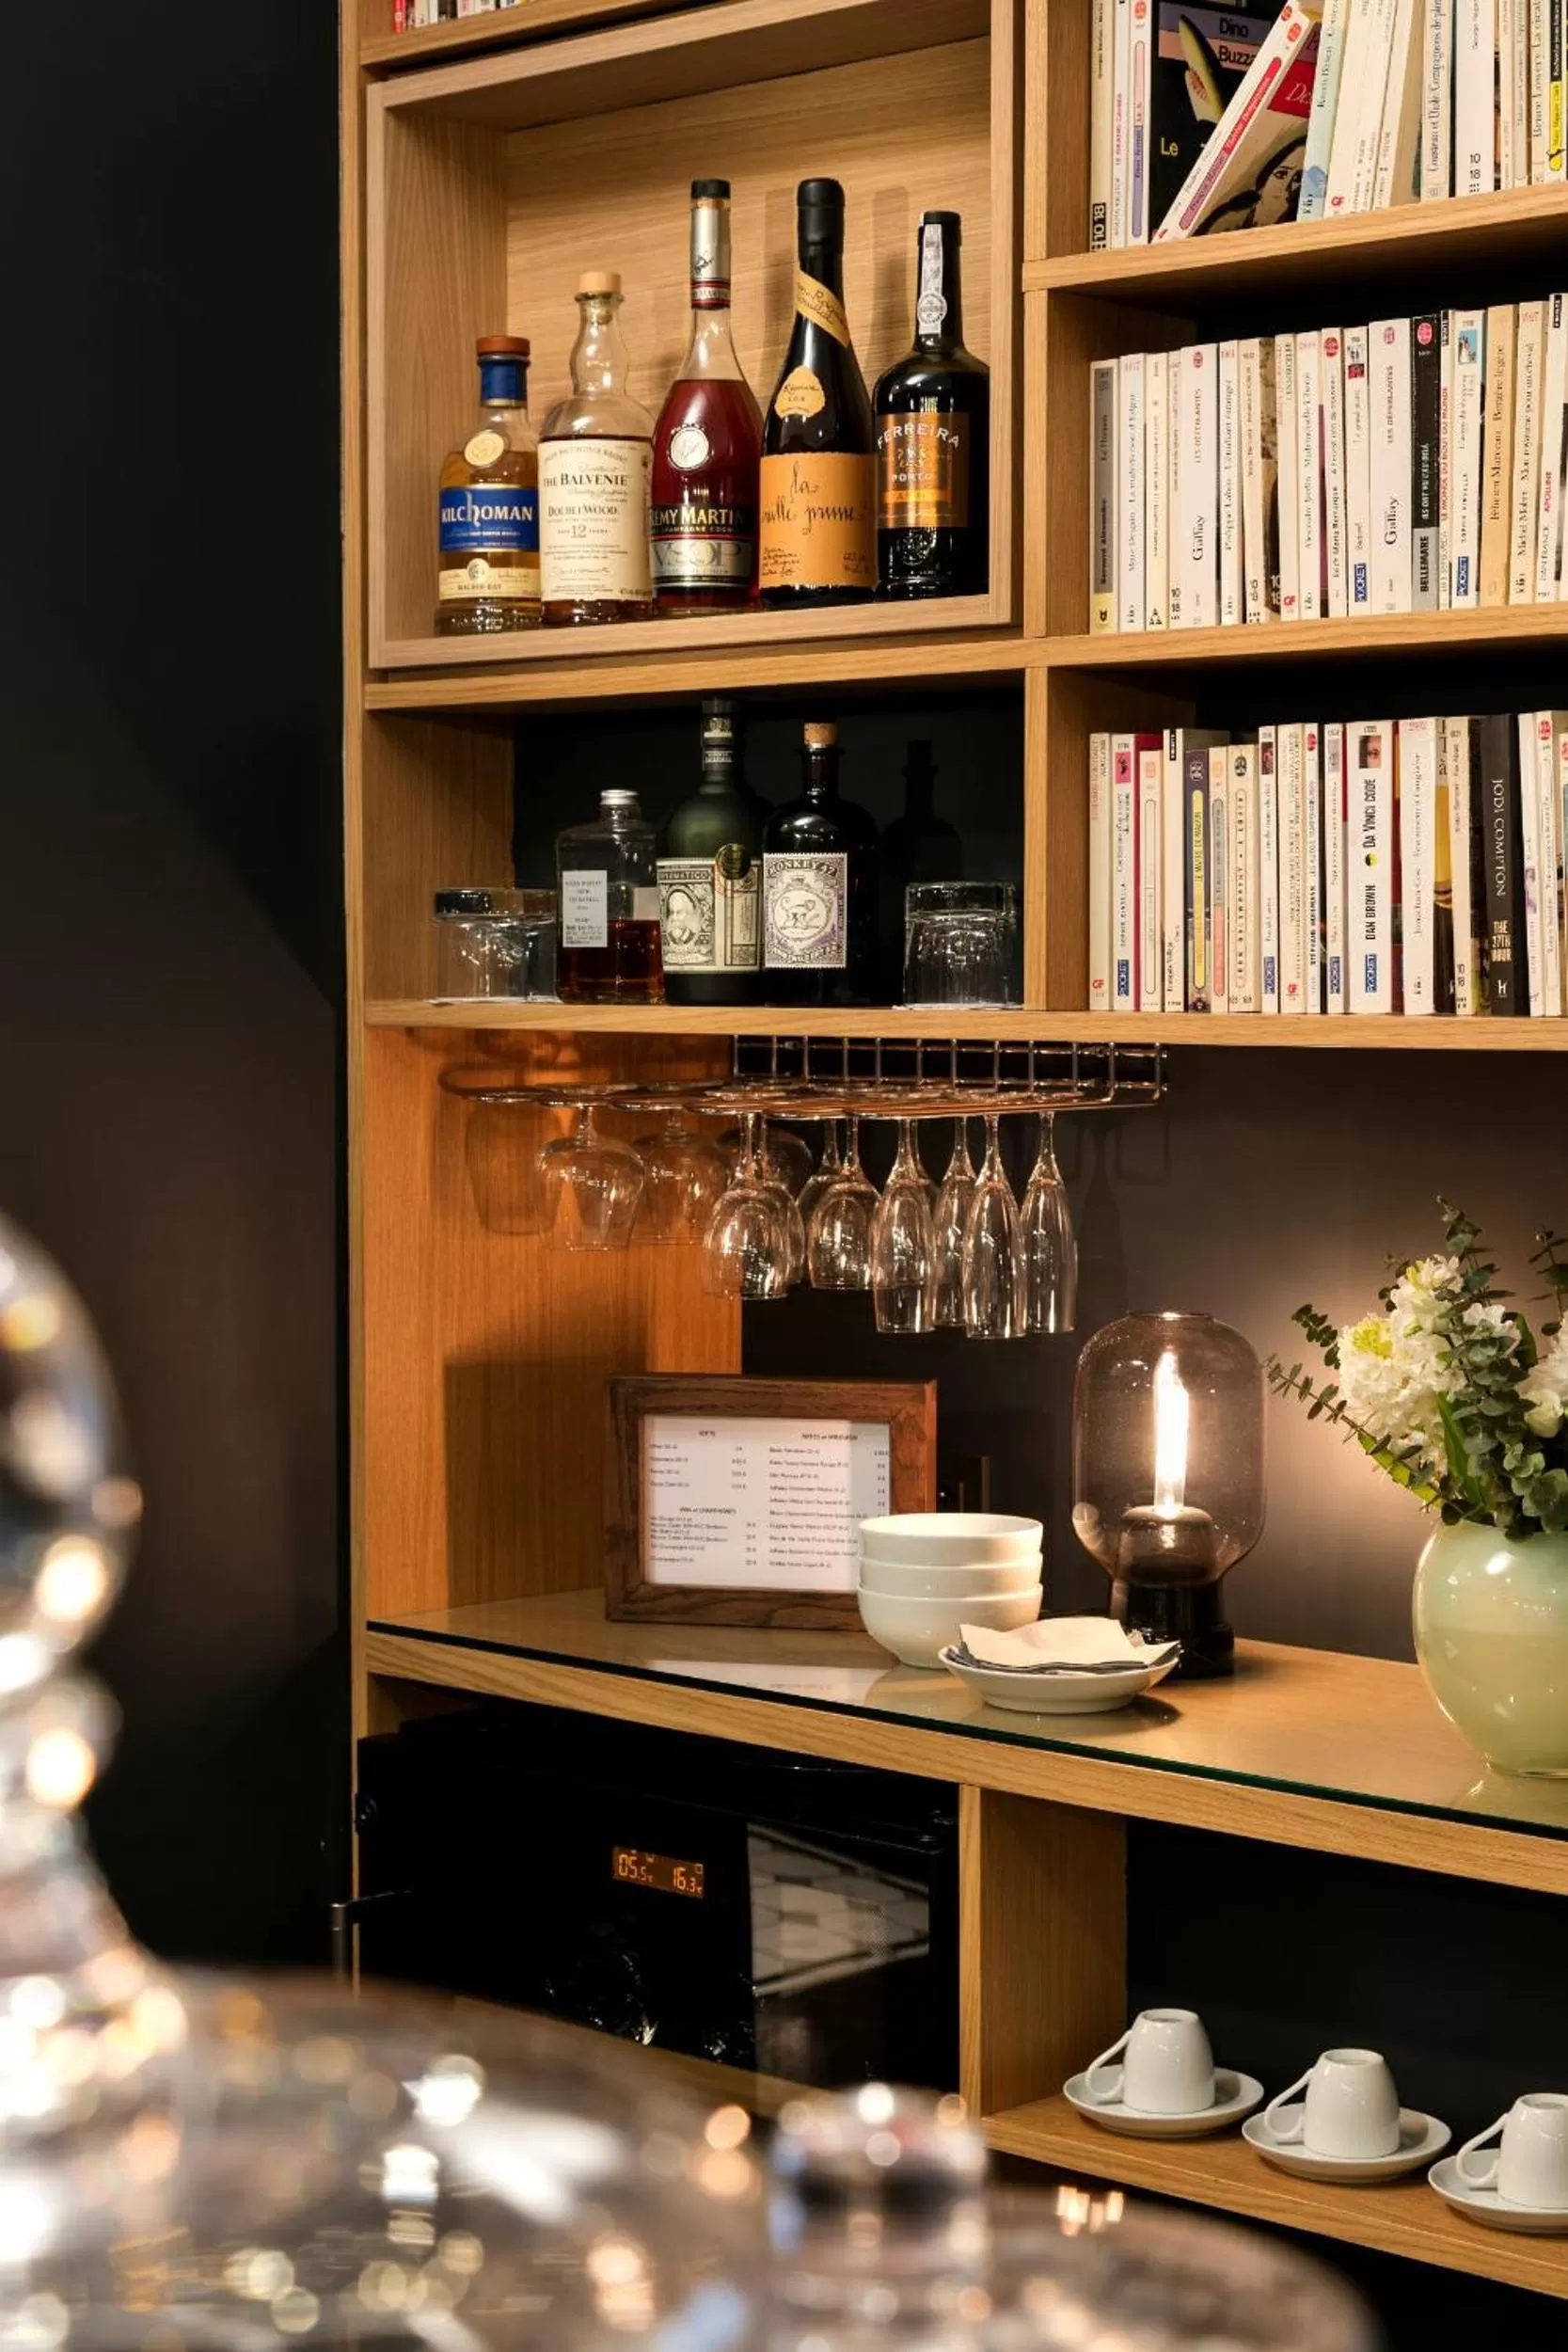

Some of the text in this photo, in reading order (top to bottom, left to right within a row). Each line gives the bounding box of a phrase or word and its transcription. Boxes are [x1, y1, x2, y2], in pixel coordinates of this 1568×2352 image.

[1218, 18, 1249, 39] Dino
[1160, 137, 1179, 157] Le
[1469, 152, 1481, 164] 10
[1469, 168, 1481, 180] 18
[877, 422, 960, 450] FERREIRA
[544, 472, 628, 487] THE BALVENIE
[892, 472, 933, 482] PORTO
[571, 524, 587, 538] 12
[805, 503, 865, 534] prune
[1384, 497, 1399, 545] Gallay
[1191, 516, 1206, 561] Gallay
[1419, 535, 1430, 593] BELLEMARE
[1354, 563, 1367, 602] POCKET
[1363, 779, 1376, 848] DA VINCI CODE
[1492, 778, 1506, 896] JODI COMPTON
[768, 858, 820, 876] MONKEY
[1365, 884, 1376, 940] DAN BROWN
[1493, 920, 1509, 934] THE
[1365, 952, 1377, 993] POCKET
